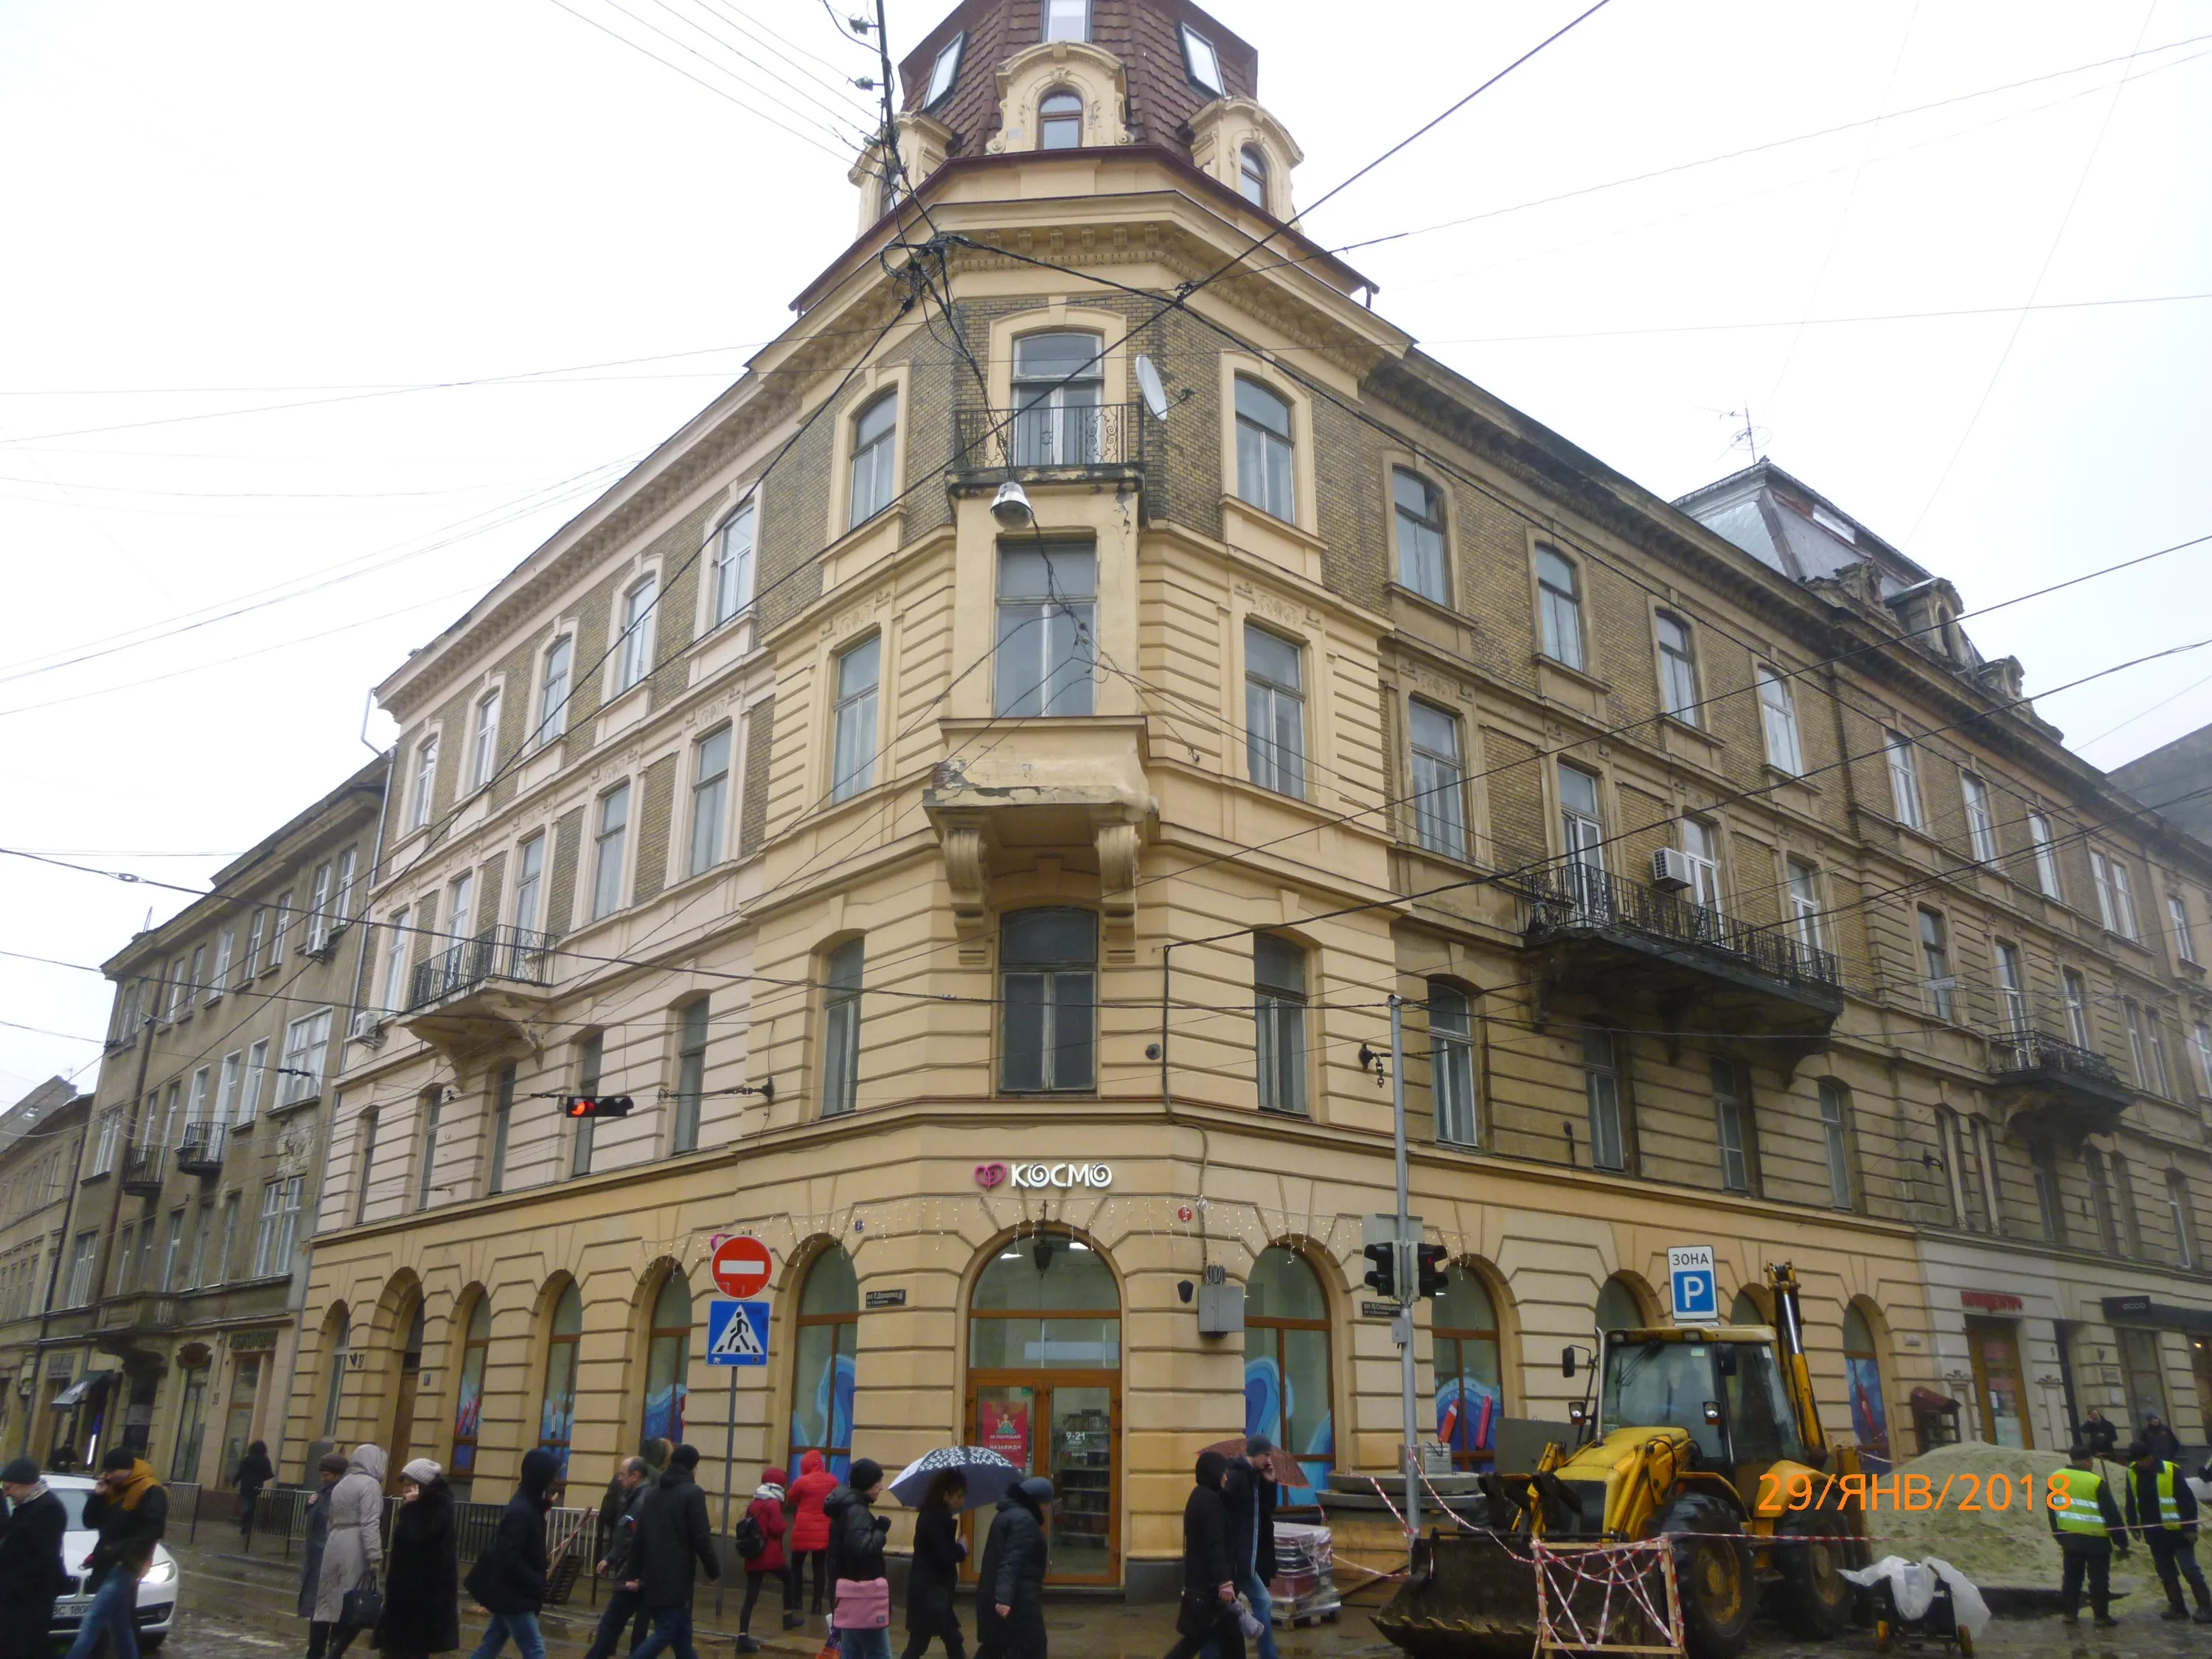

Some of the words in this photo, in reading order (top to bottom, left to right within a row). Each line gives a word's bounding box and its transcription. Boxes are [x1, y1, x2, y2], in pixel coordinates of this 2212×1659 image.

[1011, 1162, 1113, 1187] КОСМО
[1672, 1253, 1709, 1266] ЗОНА
[1683, 1276, 1704, 1308] P
[1065, 1431, 1085, 1440] 9-21
